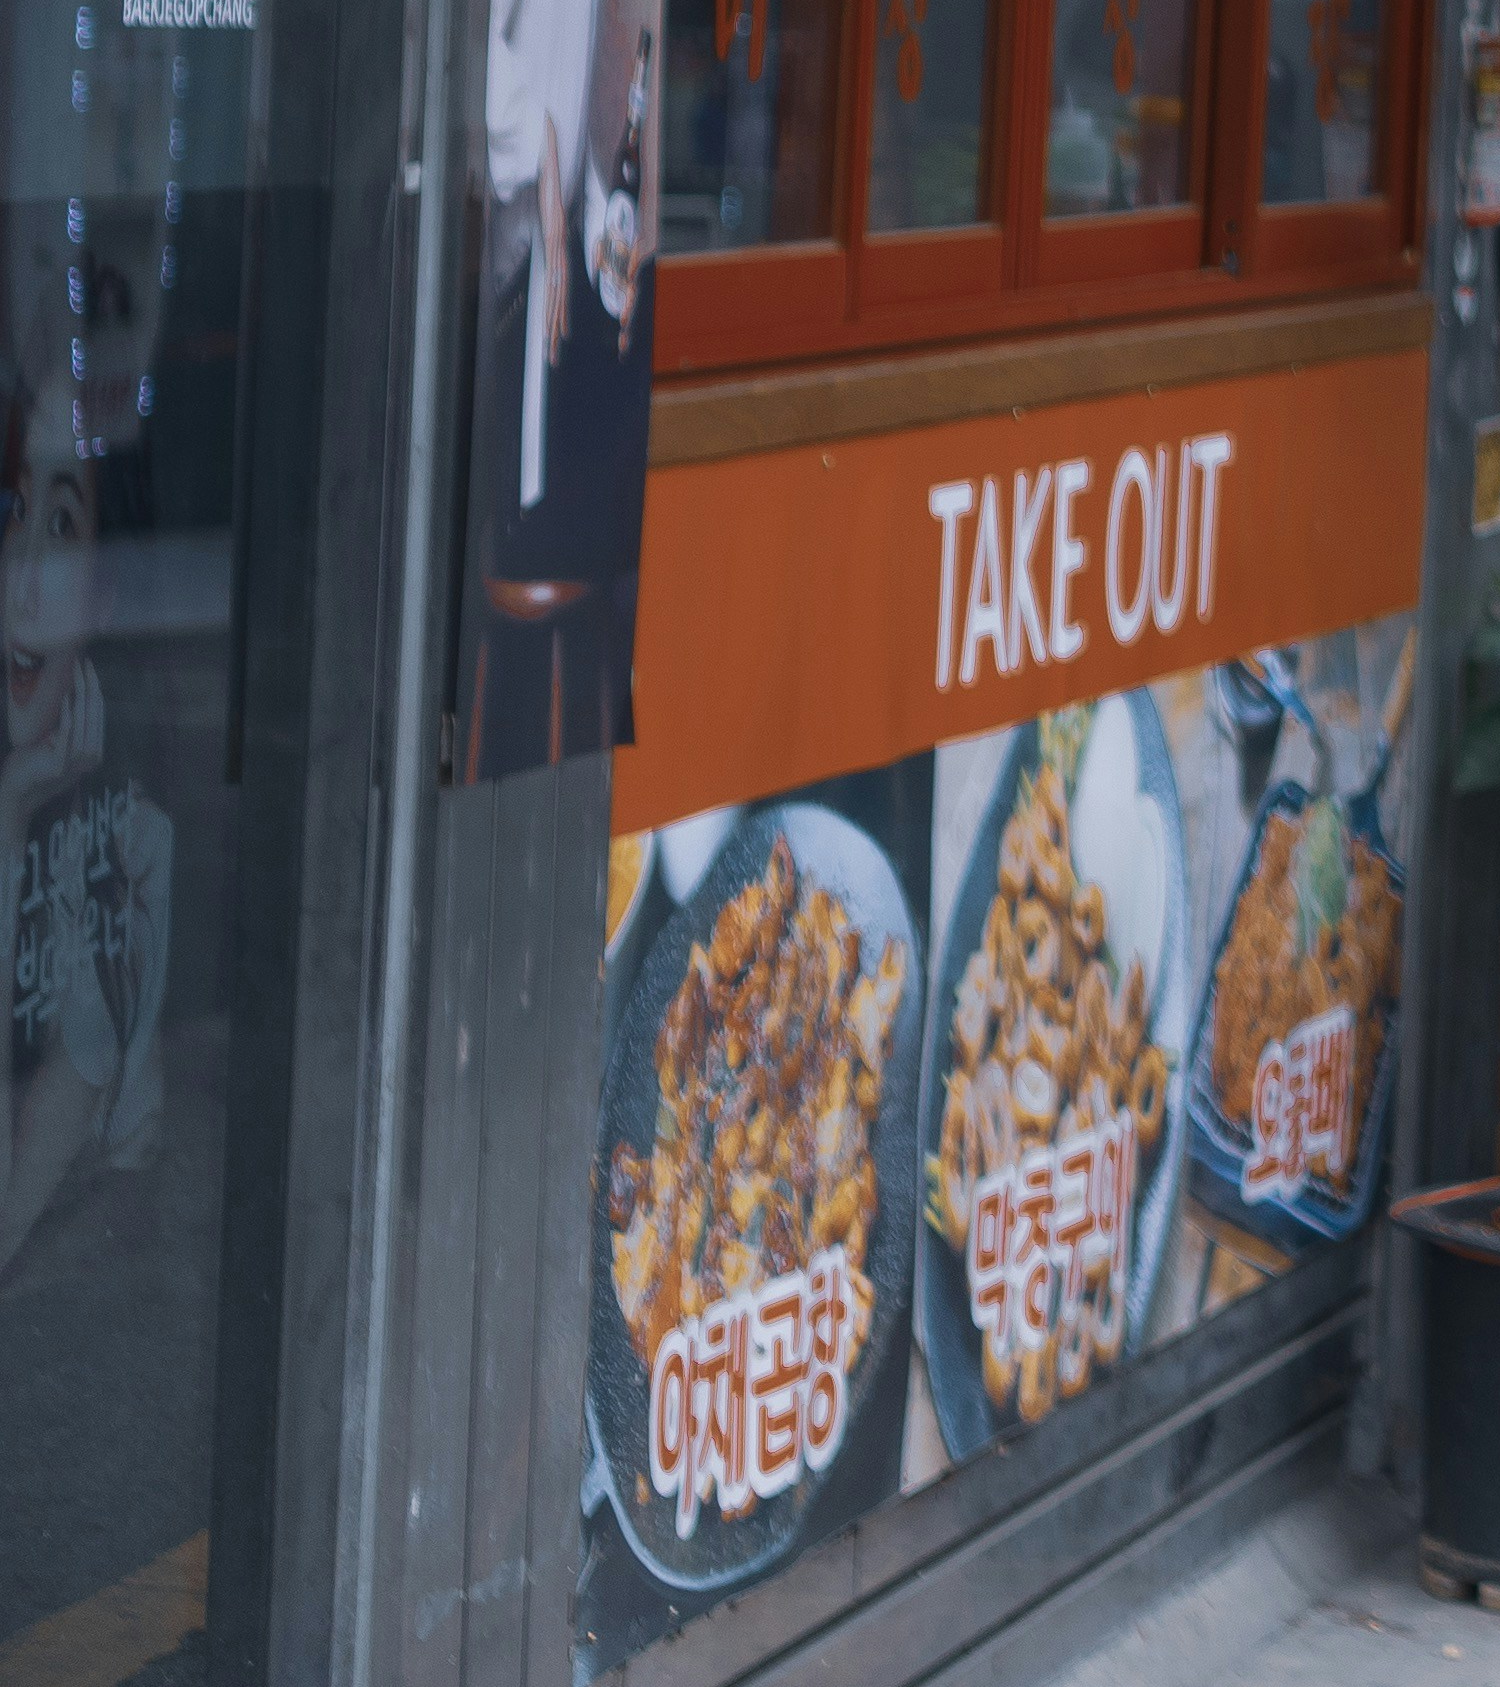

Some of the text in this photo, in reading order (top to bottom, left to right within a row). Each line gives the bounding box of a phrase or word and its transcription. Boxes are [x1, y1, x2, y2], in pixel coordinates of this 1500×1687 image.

[929, 433, 1233, 692] TAKE OUT
[969, 1116, 1135, 1350] 막창구이
[652, 1247, 853, 1538] 야채곱창
